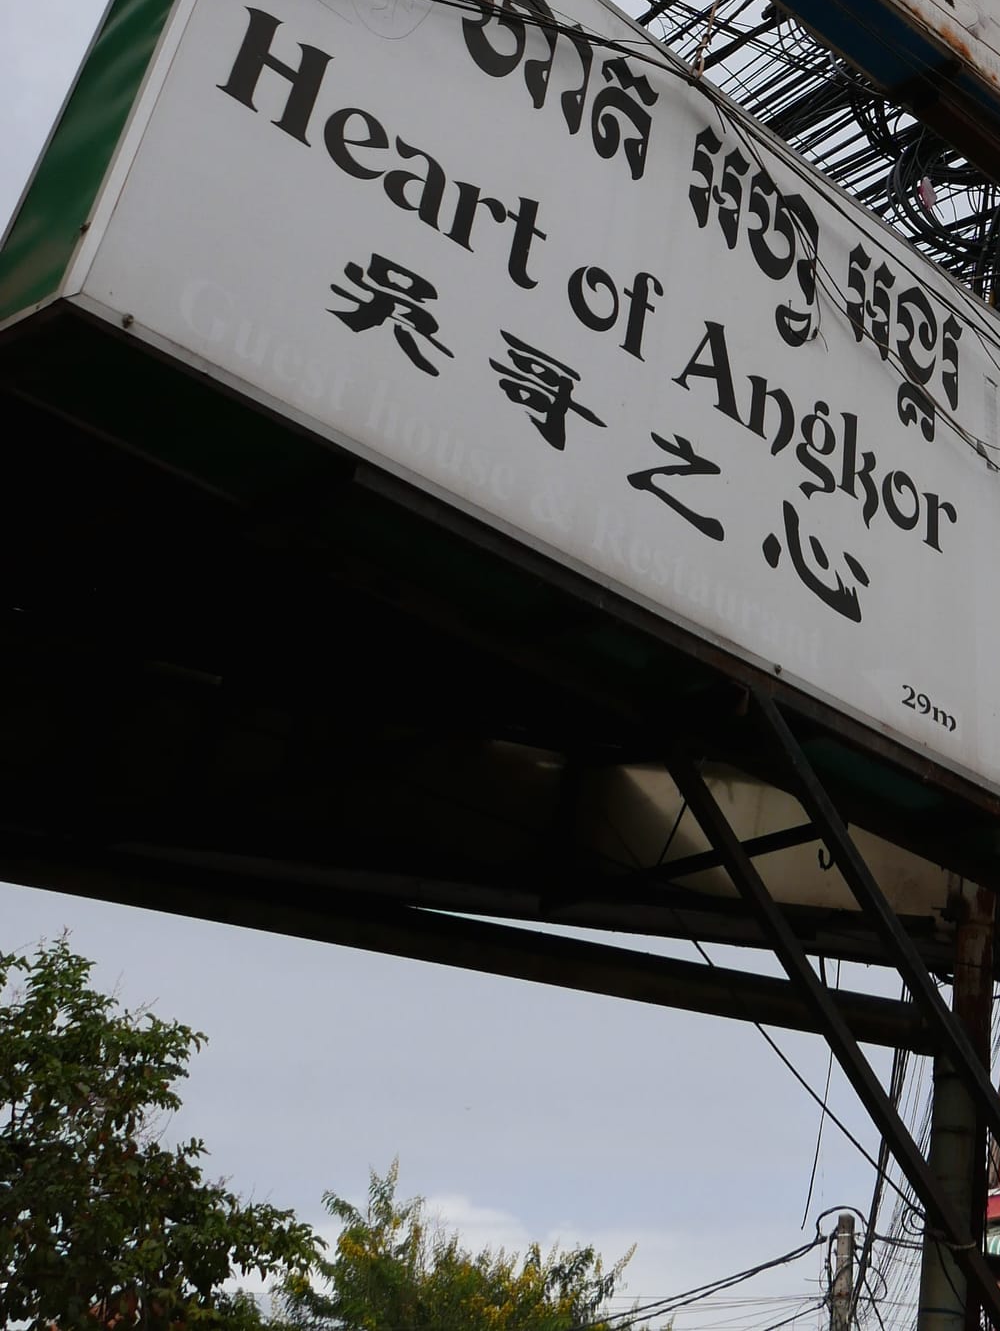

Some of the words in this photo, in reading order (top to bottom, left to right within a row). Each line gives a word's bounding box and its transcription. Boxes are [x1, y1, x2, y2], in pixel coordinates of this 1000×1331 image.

[216, 7, 547, 290] Heart
[568, 266, 663, 362] of
[672, 321, 958, 554] Angkor
[847, 242, 963, 442] អង្គរ
[901, 684, 957, 733] 29m
